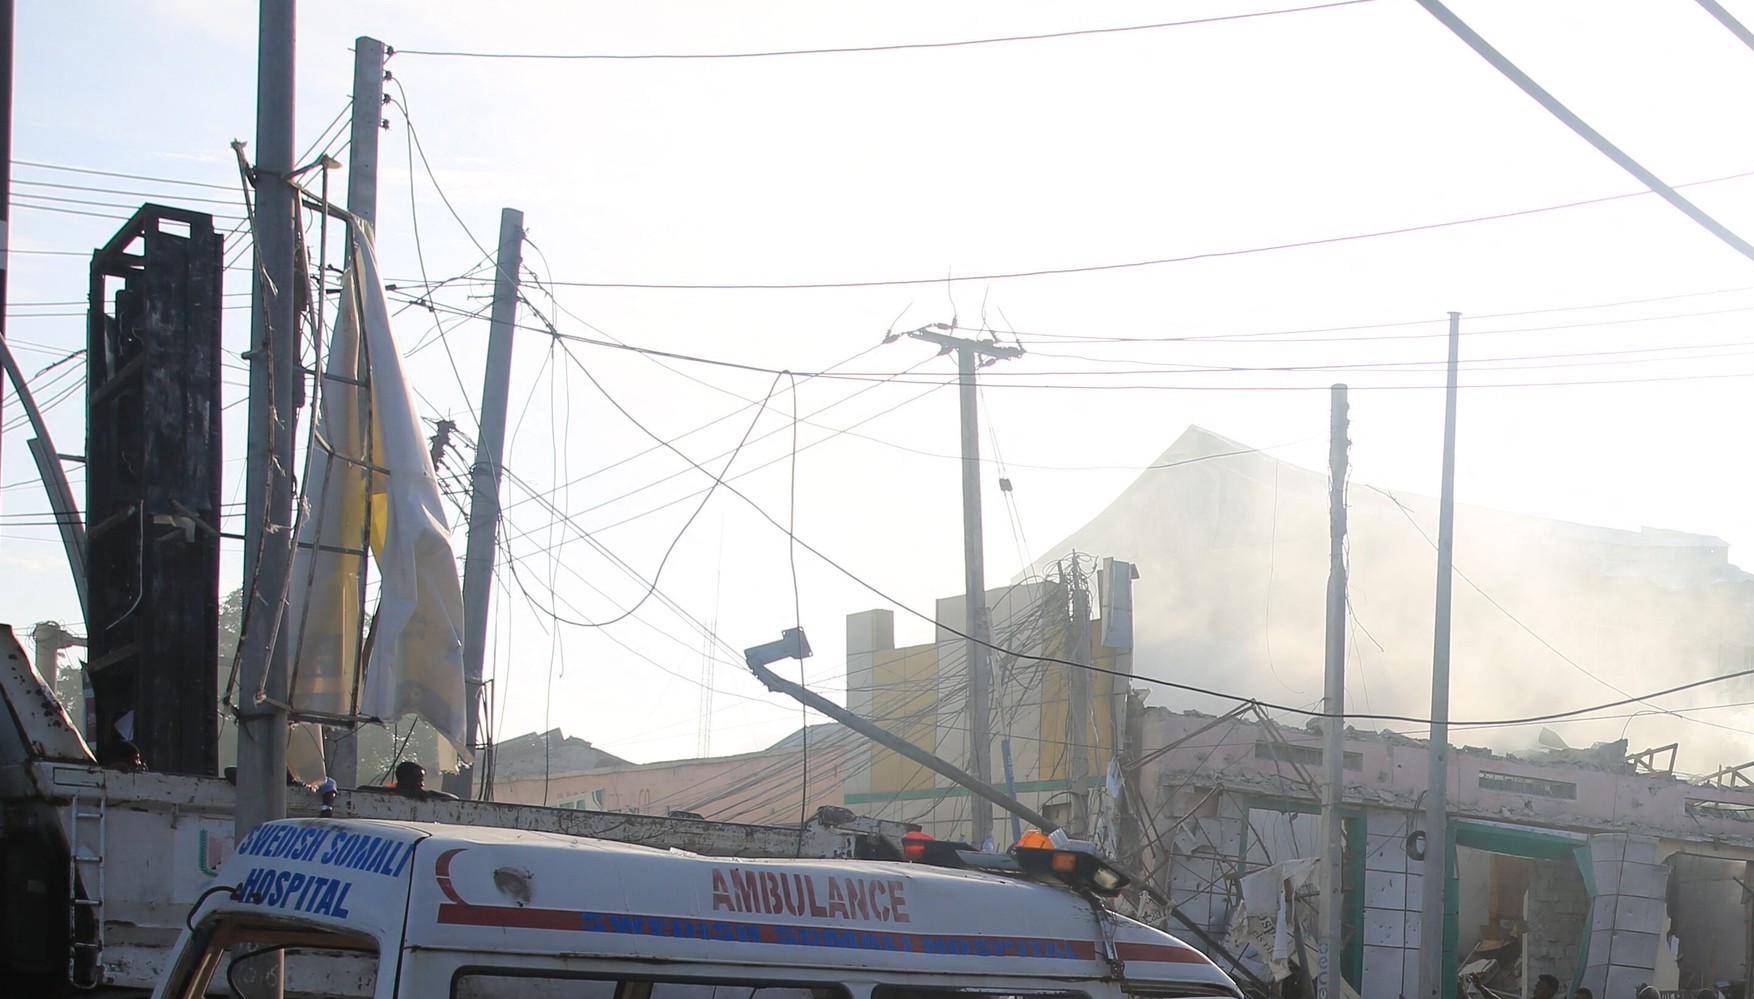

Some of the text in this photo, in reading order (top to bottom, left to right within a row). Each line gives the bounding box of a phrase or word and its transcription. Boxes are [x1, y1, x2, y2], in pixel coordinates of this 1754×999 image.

[238, 824, 415, 878] SWEDISH SOMALI
[240, 868, 352, 919] HOSPITAL
[711, 868, 911, 923] AMBULANCE
[580, 912, 1077, 960] SWEDISH SOMALI HOSPITAL
